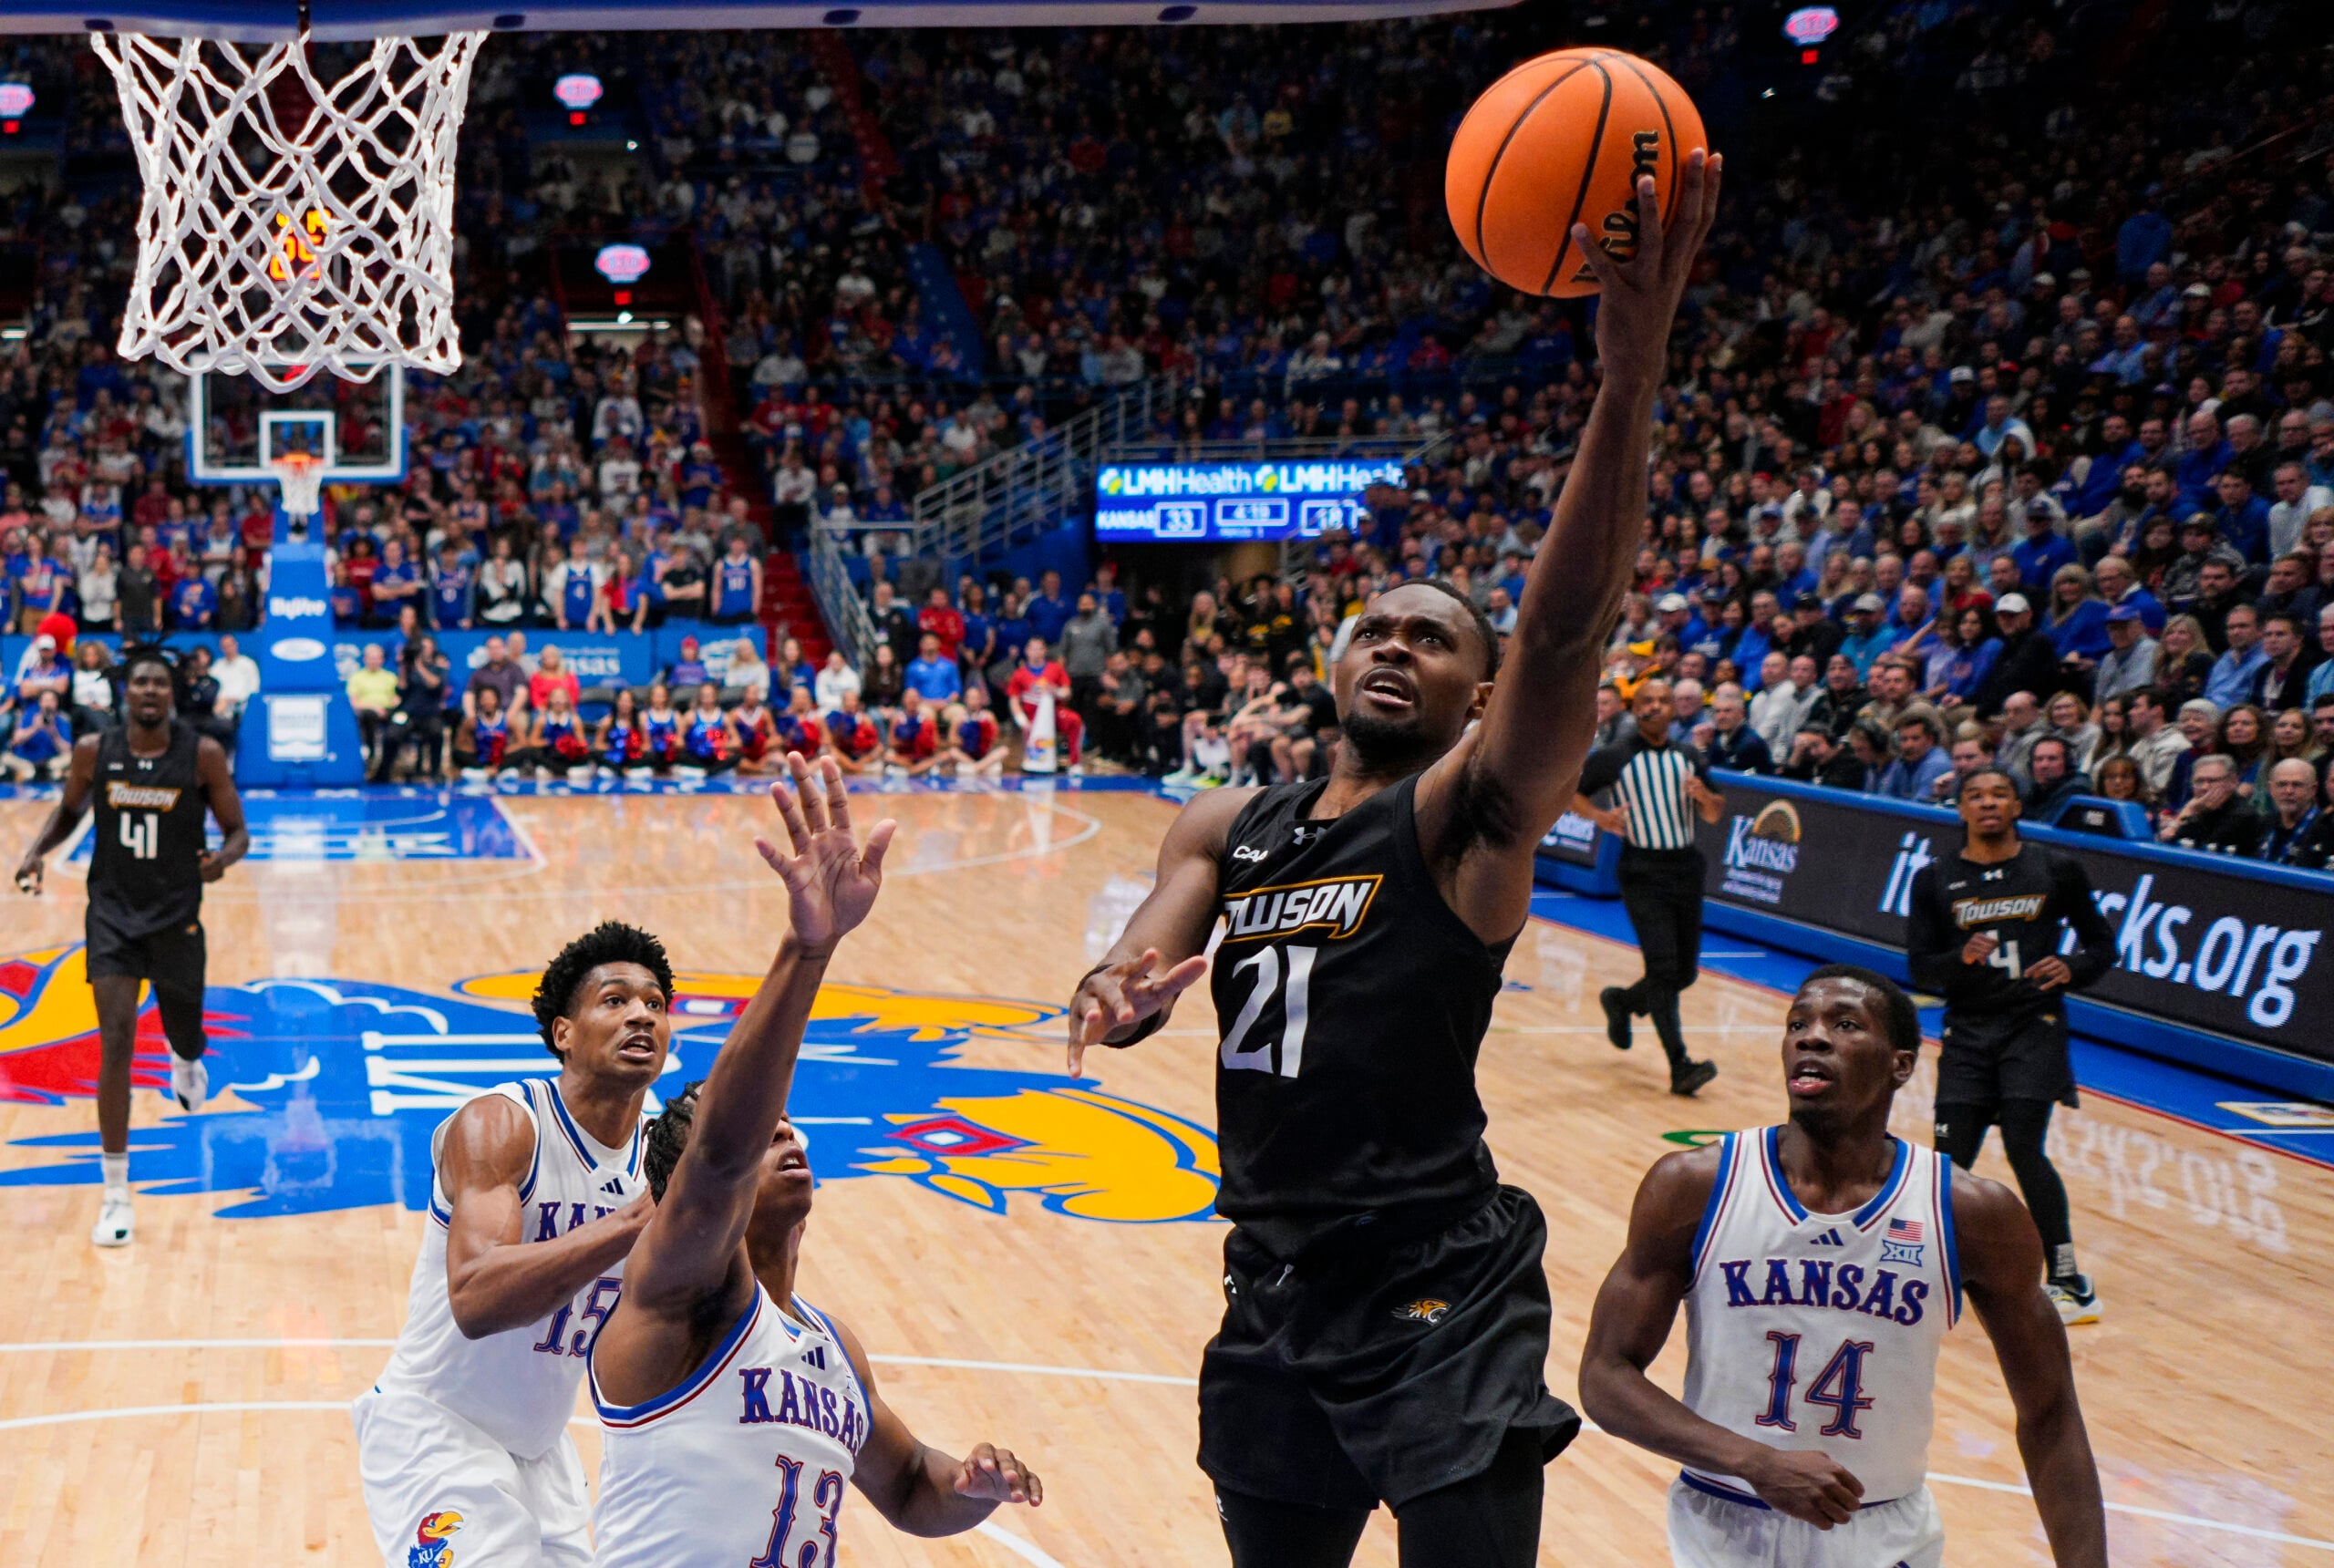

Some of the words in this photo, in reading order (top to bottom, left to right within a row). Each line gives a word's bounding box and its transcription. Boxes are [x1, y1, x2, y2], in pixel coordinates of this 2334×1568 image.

[1167, 509, 1194, 531] 33
[107, 780, 179, 811] TOWSON
[119, 810, 159, 860] 41
[1722, 814, 1799, 873] Kansas
[1955, 896, 2044, 926] TOWSON
[1985, 929, 2021, 980] 4
[1220, 944, 1318, 1079] 21
[532, 1276, 624, 1358] 15
[1720, 1259, 1929, 1326] KANSAS
[1755, 1330, 1875, 1439] 14
[749, 1454, 843, 1568] 13
